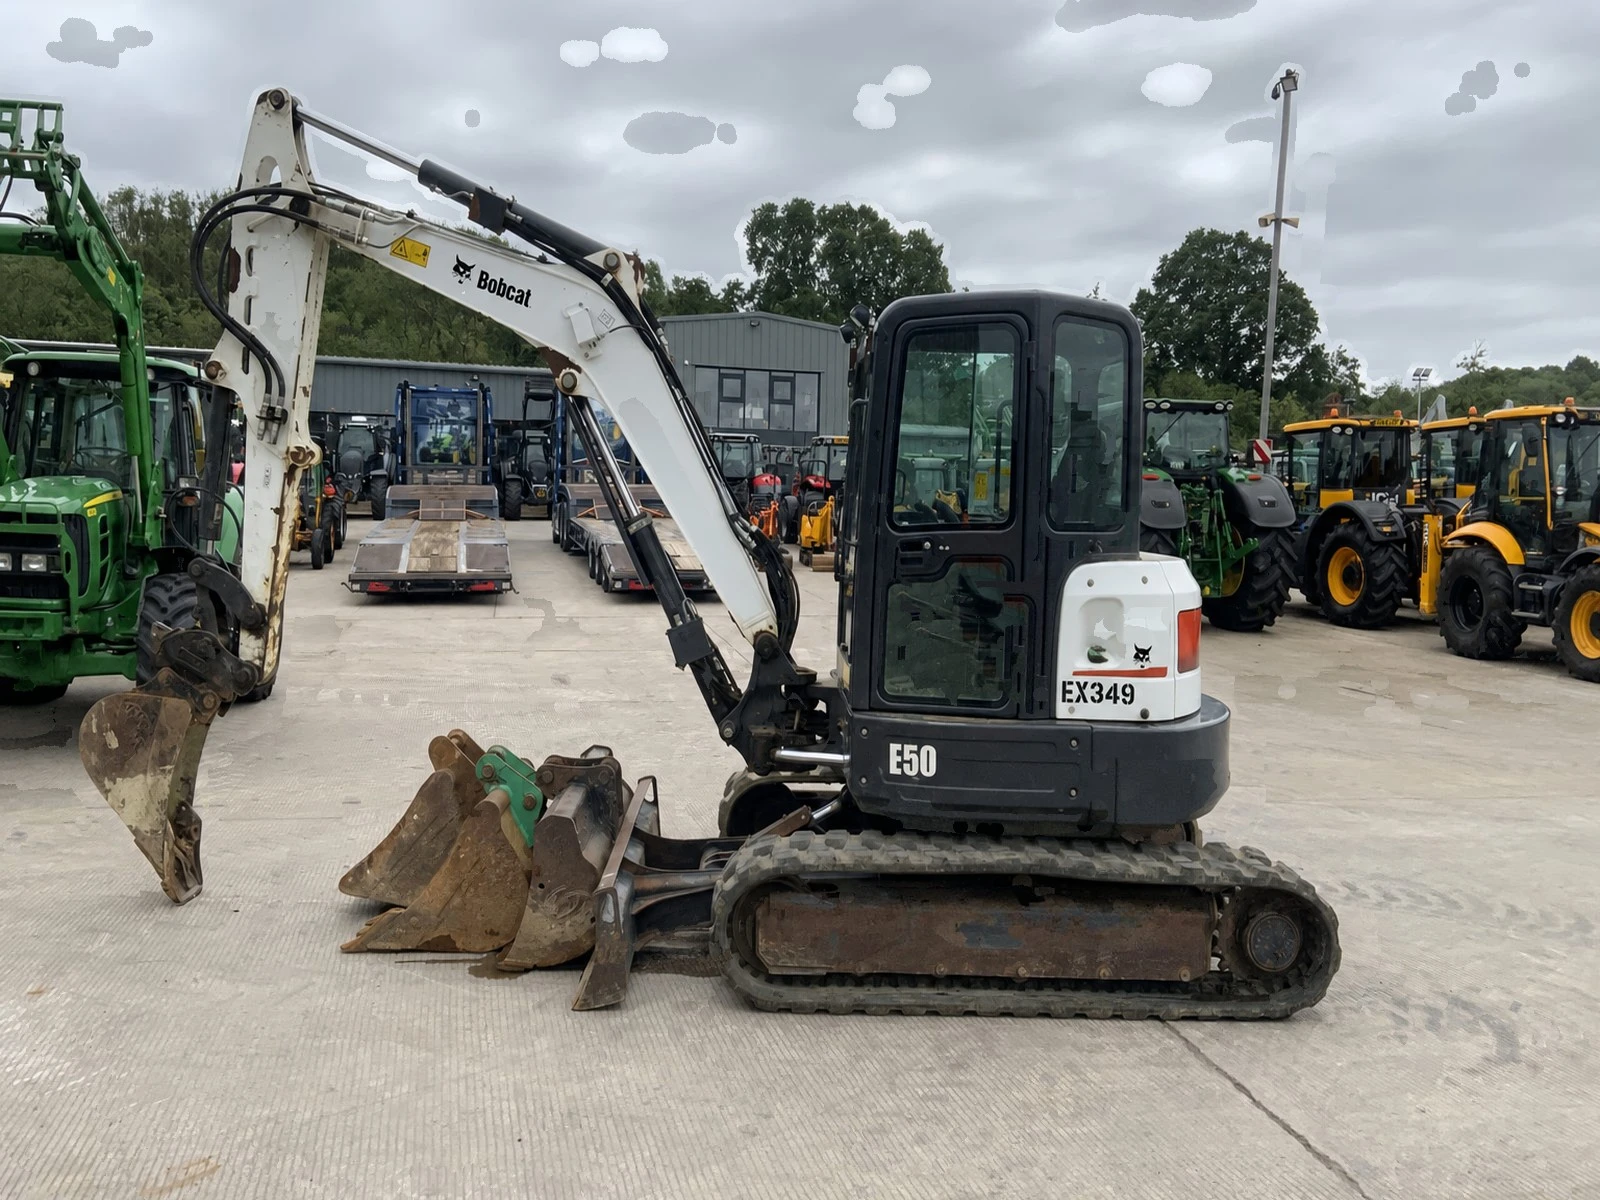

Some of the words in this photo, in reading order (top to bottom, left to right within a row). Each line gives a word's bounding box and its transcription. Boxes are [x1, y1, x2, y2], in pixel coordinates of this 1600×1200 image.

[477, 270, 532, 308] Bobcat
[1061, 680, 1135, 705] EX349
[889, 743, 937, 778] E50
